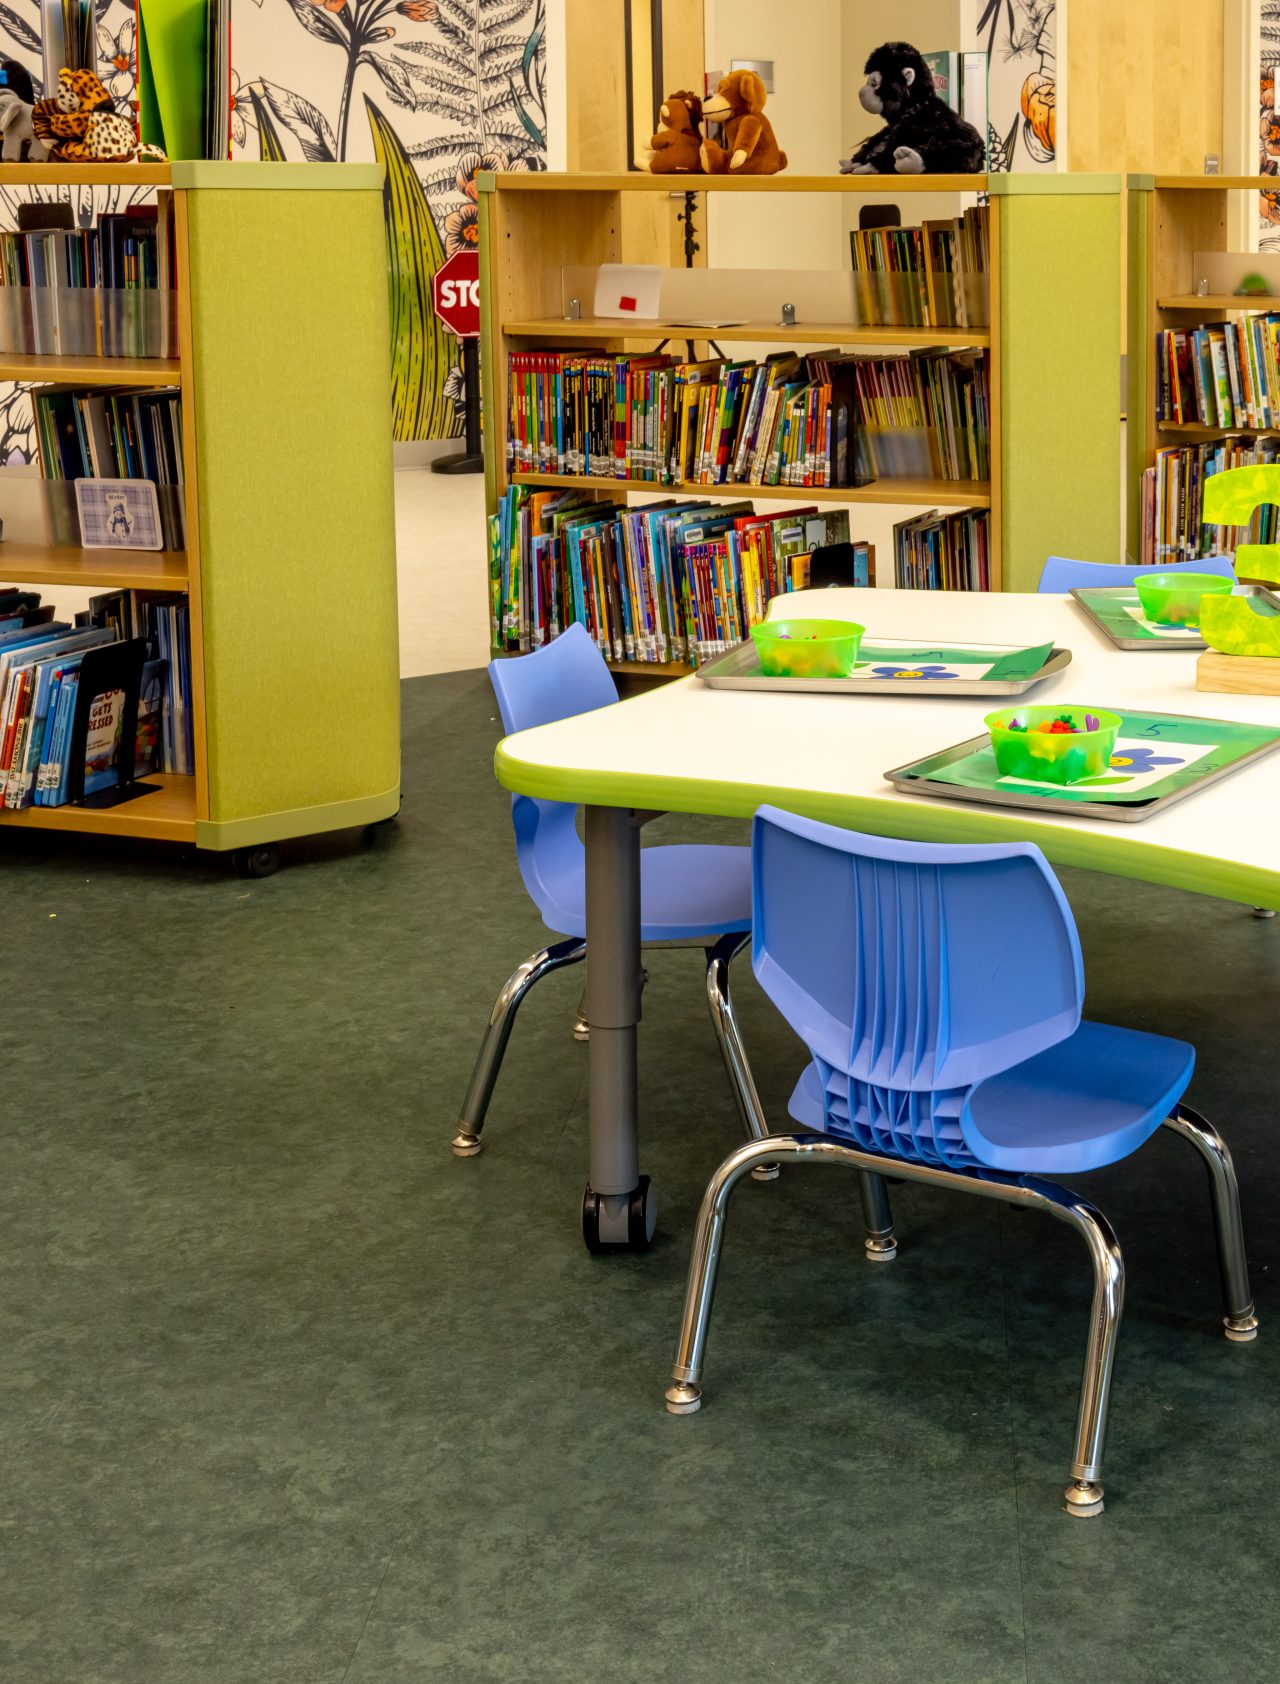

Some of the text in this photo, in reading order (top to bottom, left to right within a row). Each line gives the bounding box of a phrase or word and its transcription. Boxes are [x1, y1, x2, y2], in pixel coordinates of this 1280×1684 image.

[440, 279, 480, 309] STO
[107, 493, 125, 501] Winter
[92, 701, 113, 718] GETS
[87, 714, 114, 732] RESSED
[1136, 723, 1178, 737] 5
